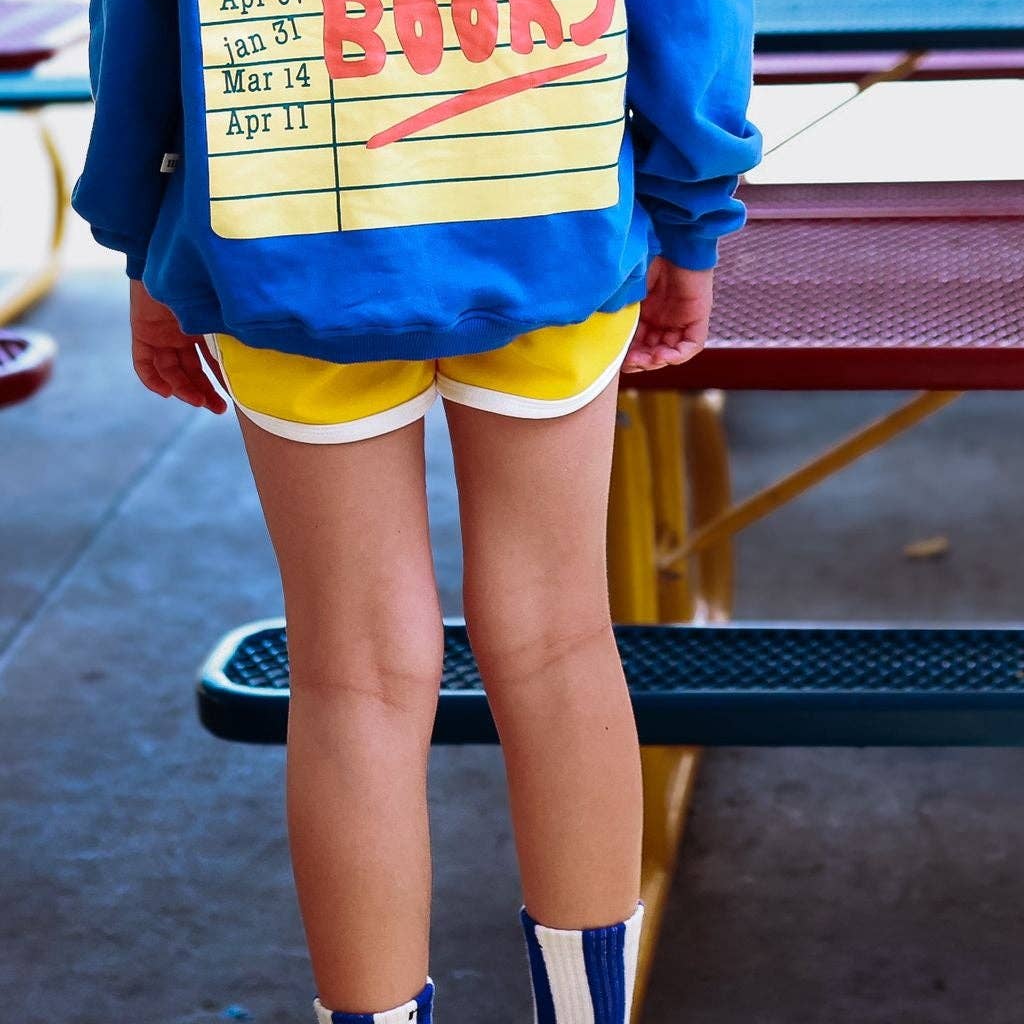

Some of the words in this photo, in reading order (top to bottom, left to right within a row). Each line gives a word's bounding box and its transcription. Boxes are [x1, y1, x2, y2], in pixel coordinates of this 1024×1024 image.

[222, 30, 267, 66] jan
[272, 15, 302, 45] 31
[222, 68, 272, 95] Mar
[283, 62, 311, 89] 14
[226, 110, 272, 138] Apr
[283, 103, 308, 130] 11
